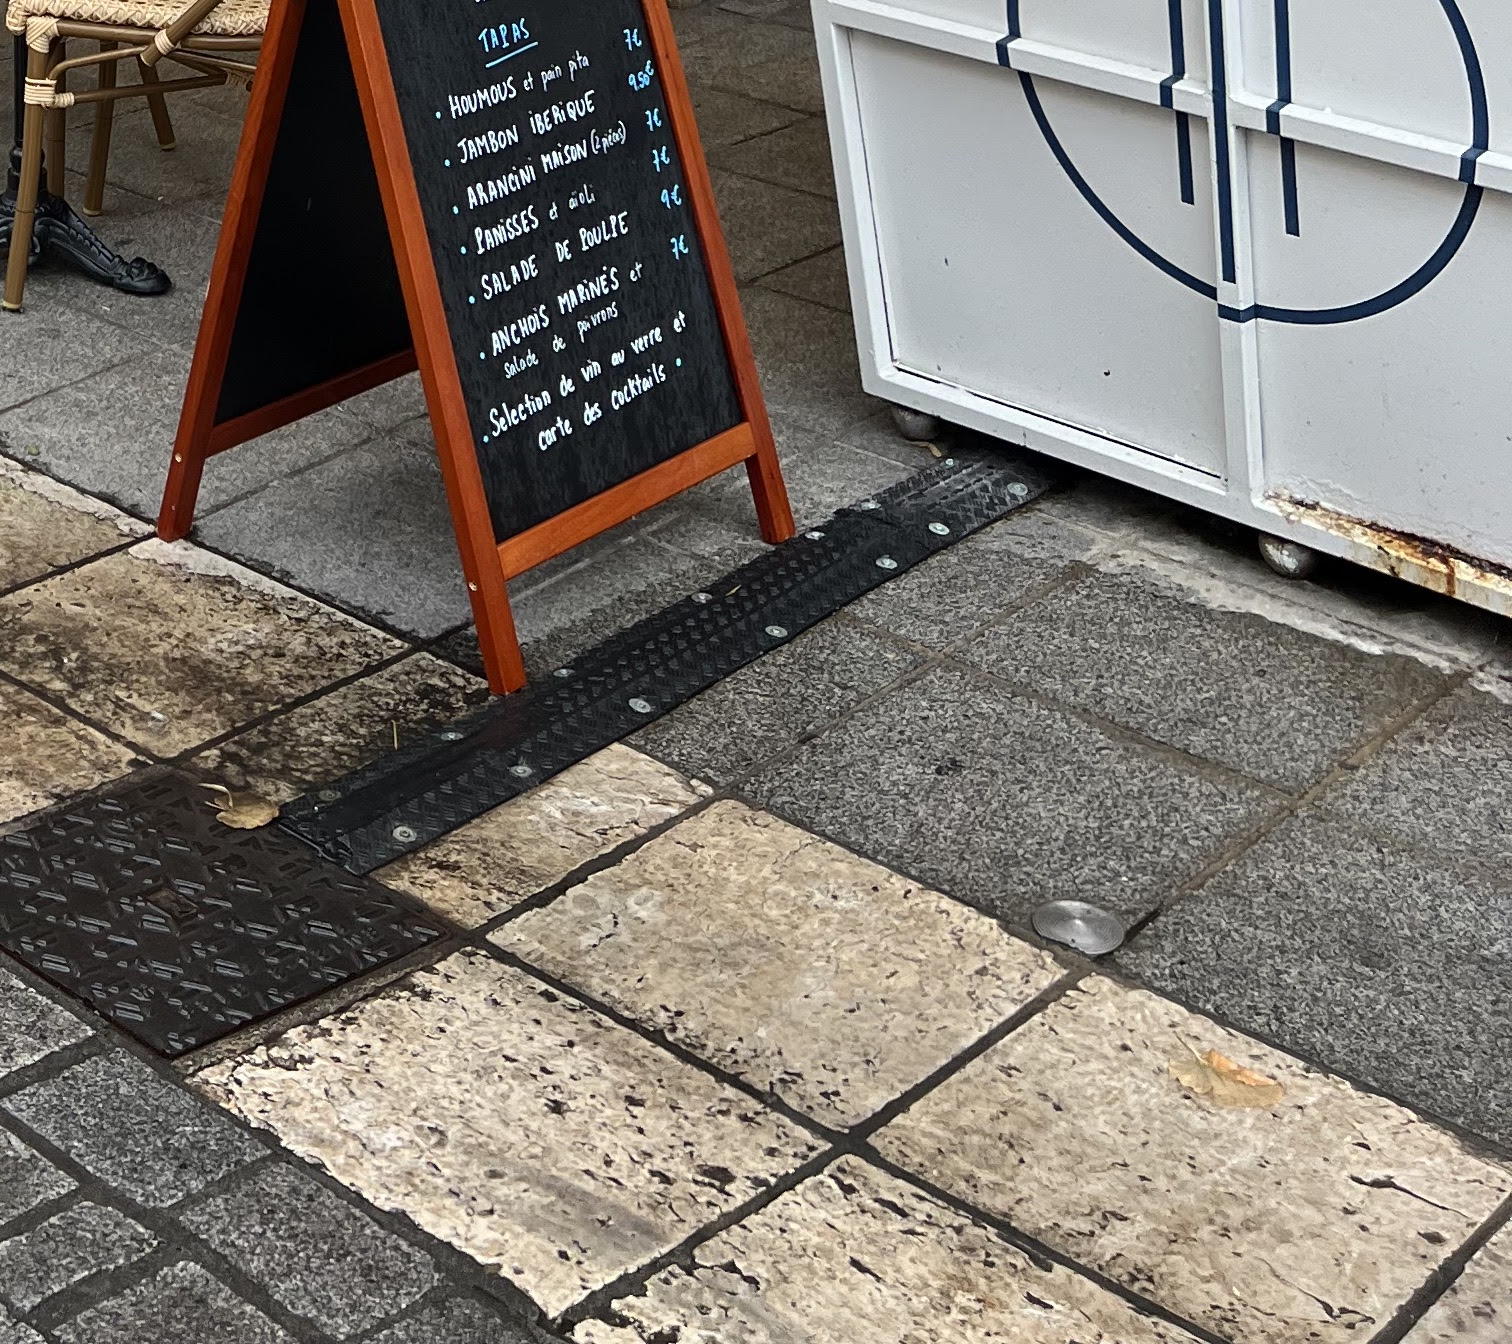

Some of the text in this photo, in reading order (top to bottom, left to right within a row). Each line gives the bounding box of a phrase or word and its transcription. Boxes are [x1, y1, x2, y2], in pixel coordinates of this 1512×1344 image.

[448, 27, 643, 120] HOUMOUS et pain pita 7€
[477, 17, 531, 53] TAPAS
[456, 124, 520, 165] JAMBON
[466, 156, 537, 210] ARANCINI
[540, 141, 589, 174] MAISON
[644, 106, 663, 133] 7€
[474, 204, 540, 256] PANISSES
[548, 201, 560, 221] et
[651, 144, 672, 173] 7€
[480, 254, 539, 301] SALADE
[554, 238, 573, 264] DE
[579, 211, 629, 253] POULPE
[491, 304, 550, 357] ANCHOIS
[629, 261, 643, 283] et
[669, 233, 689, 261] 7€
[552, 333, 567, 354] de
[576, 300, 619, 344] poivrons
[489, 309, 687, 438] Selection de vin au verre et
[582, 400, 603, 426] des
